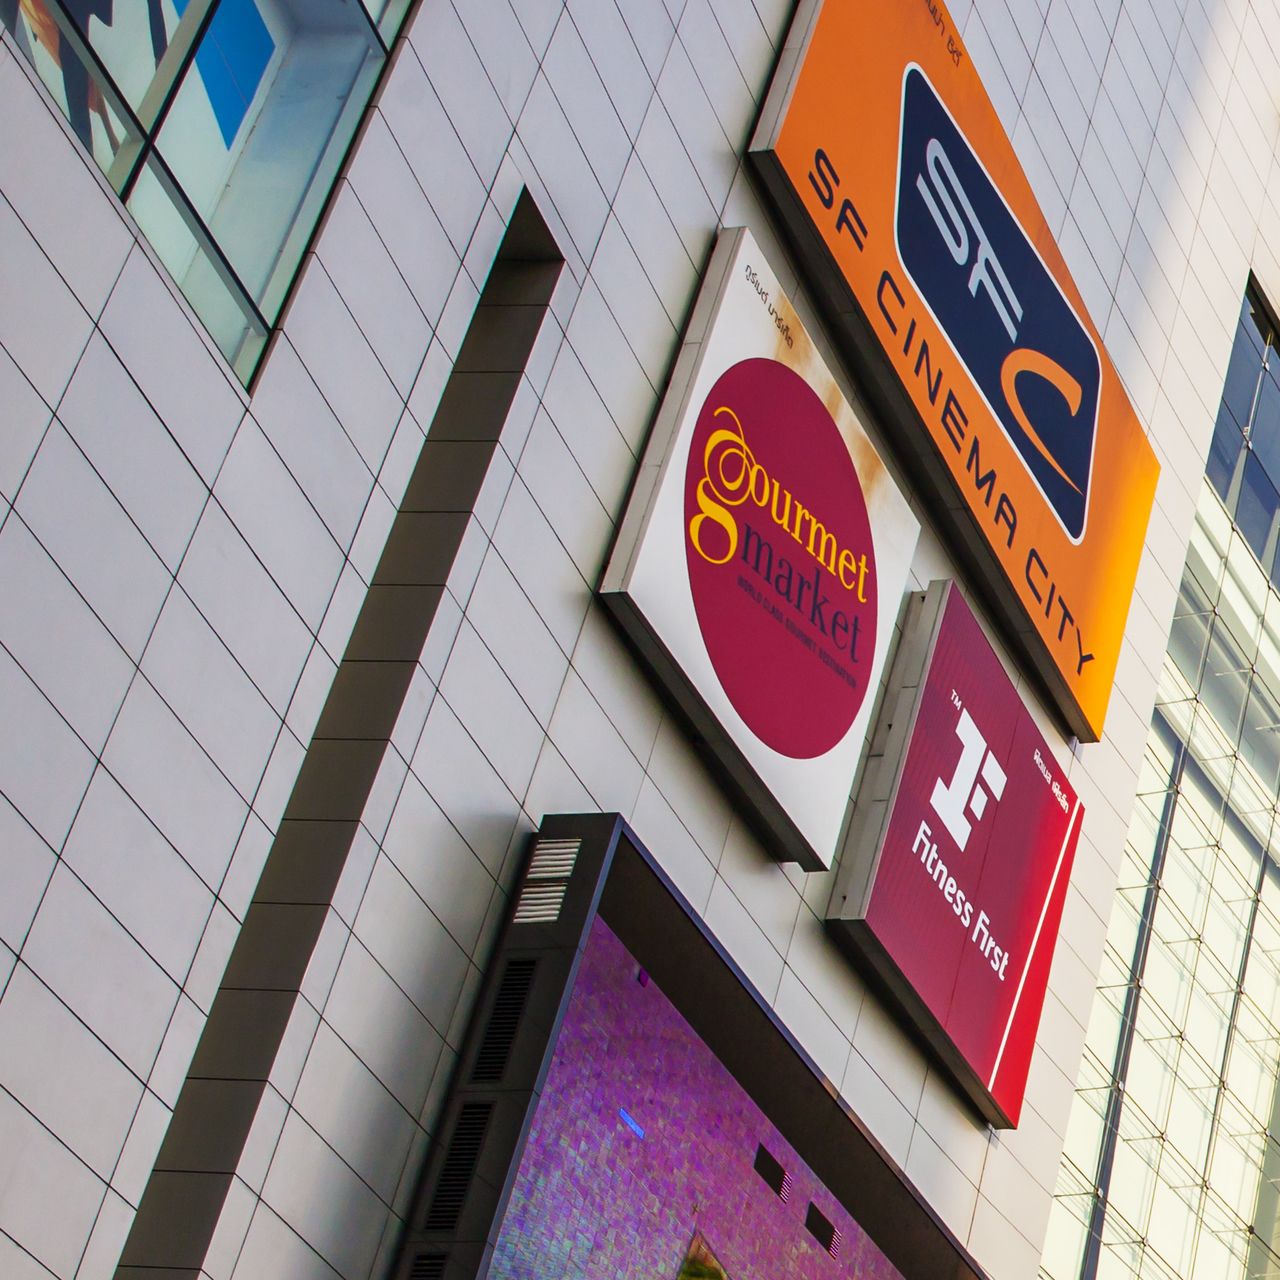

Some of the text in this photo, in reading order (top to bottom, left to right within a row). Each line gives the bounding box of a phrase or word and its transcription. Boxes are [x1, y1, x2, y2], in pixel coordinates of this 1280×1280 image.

[808, 148, 1095, 677] SF CINEMA CITY
[689, 406, 869, 603] gourmet
[741, 522, 862, 663] market
[911, 820, 1009, 981] Fitness First
